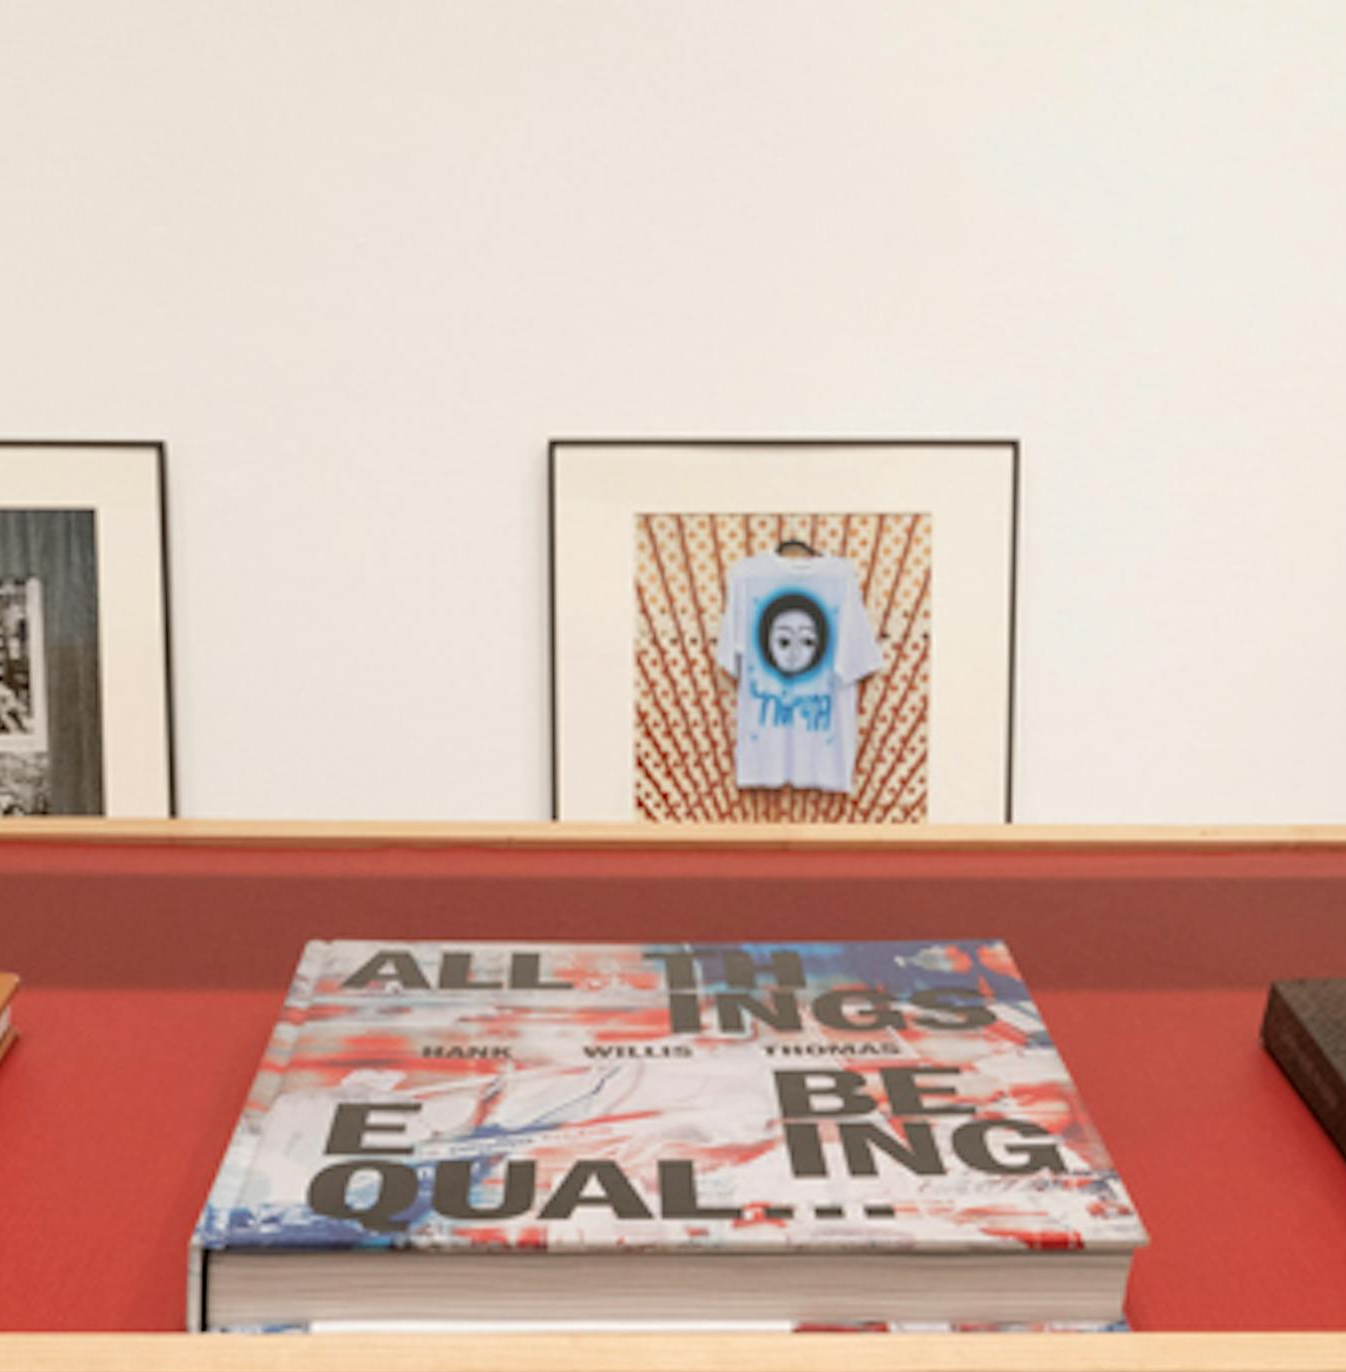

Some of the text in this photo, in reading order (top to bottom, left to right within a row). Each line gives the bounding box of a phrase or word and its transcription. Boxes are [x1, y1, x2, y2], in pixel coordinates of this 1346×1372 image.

[340, 949, 807, 990] ALL TH
[669, 987, 999, 1034] INGS
[422, 1043, 902, 1060] HANK WILLIS THOMAS
[774, 1066, 976, 1118] BE
[322, 1102, 422, 1155] E
[783, 1119, 1071, 1178] ING
[306, 1159, 895, 1233] QUAL...
